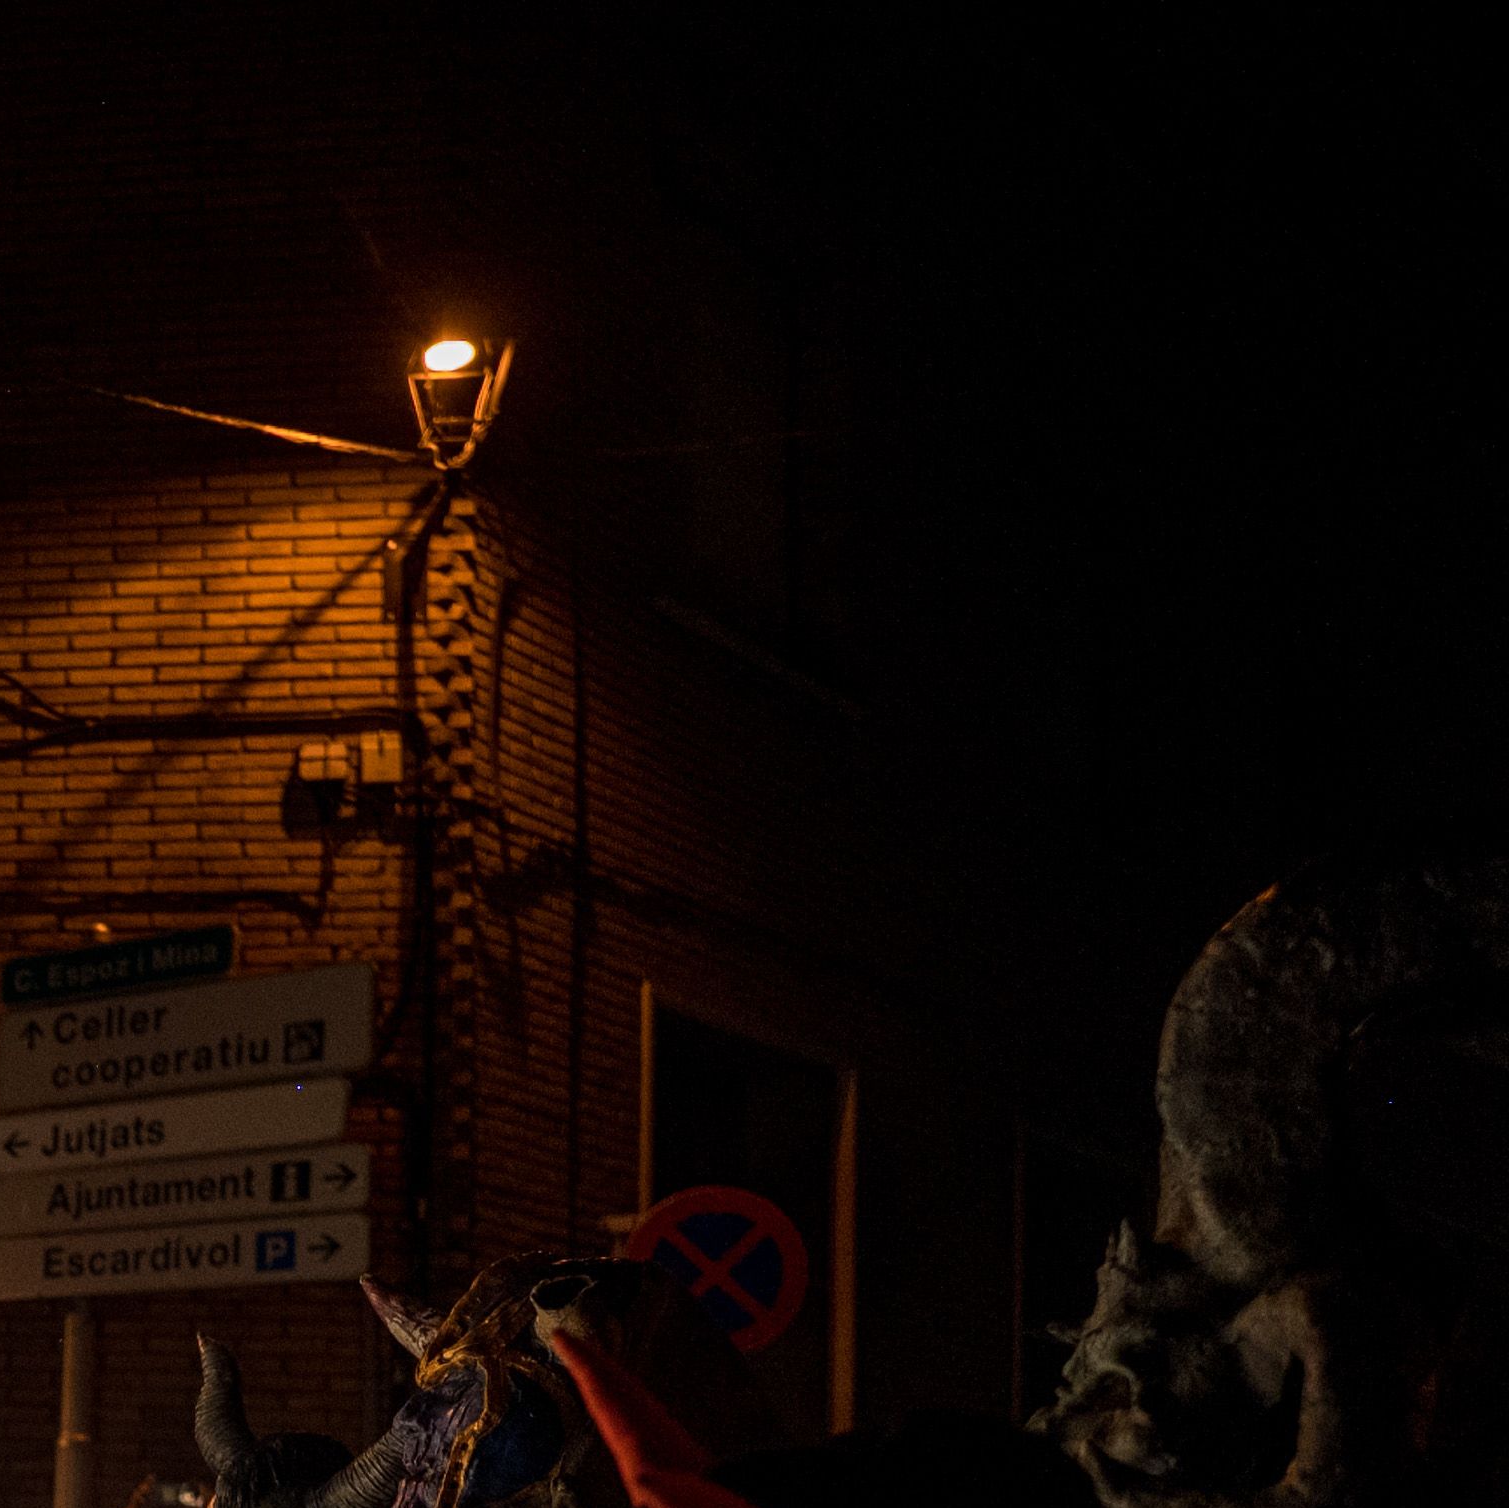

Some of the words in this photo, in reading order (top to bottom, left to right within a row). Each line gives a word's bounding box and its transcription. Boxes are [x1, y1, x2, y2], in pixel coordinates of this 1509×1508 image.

[14, 968, 40, 993] C.
[47, 956, 130, 988] Espoz
[152, 942, 218, 972] Mina
[53, 1005, 169, 1044] Celler
[52, 1033, 270, 1089] cooperatiu
[41, 1115, 166, 1159] Jutjats
[48, 1165, 255, 1219] Ajuntament
[43, 1234, 241, 1278] Escardivol
[265, 1236, 290, 1268] P
